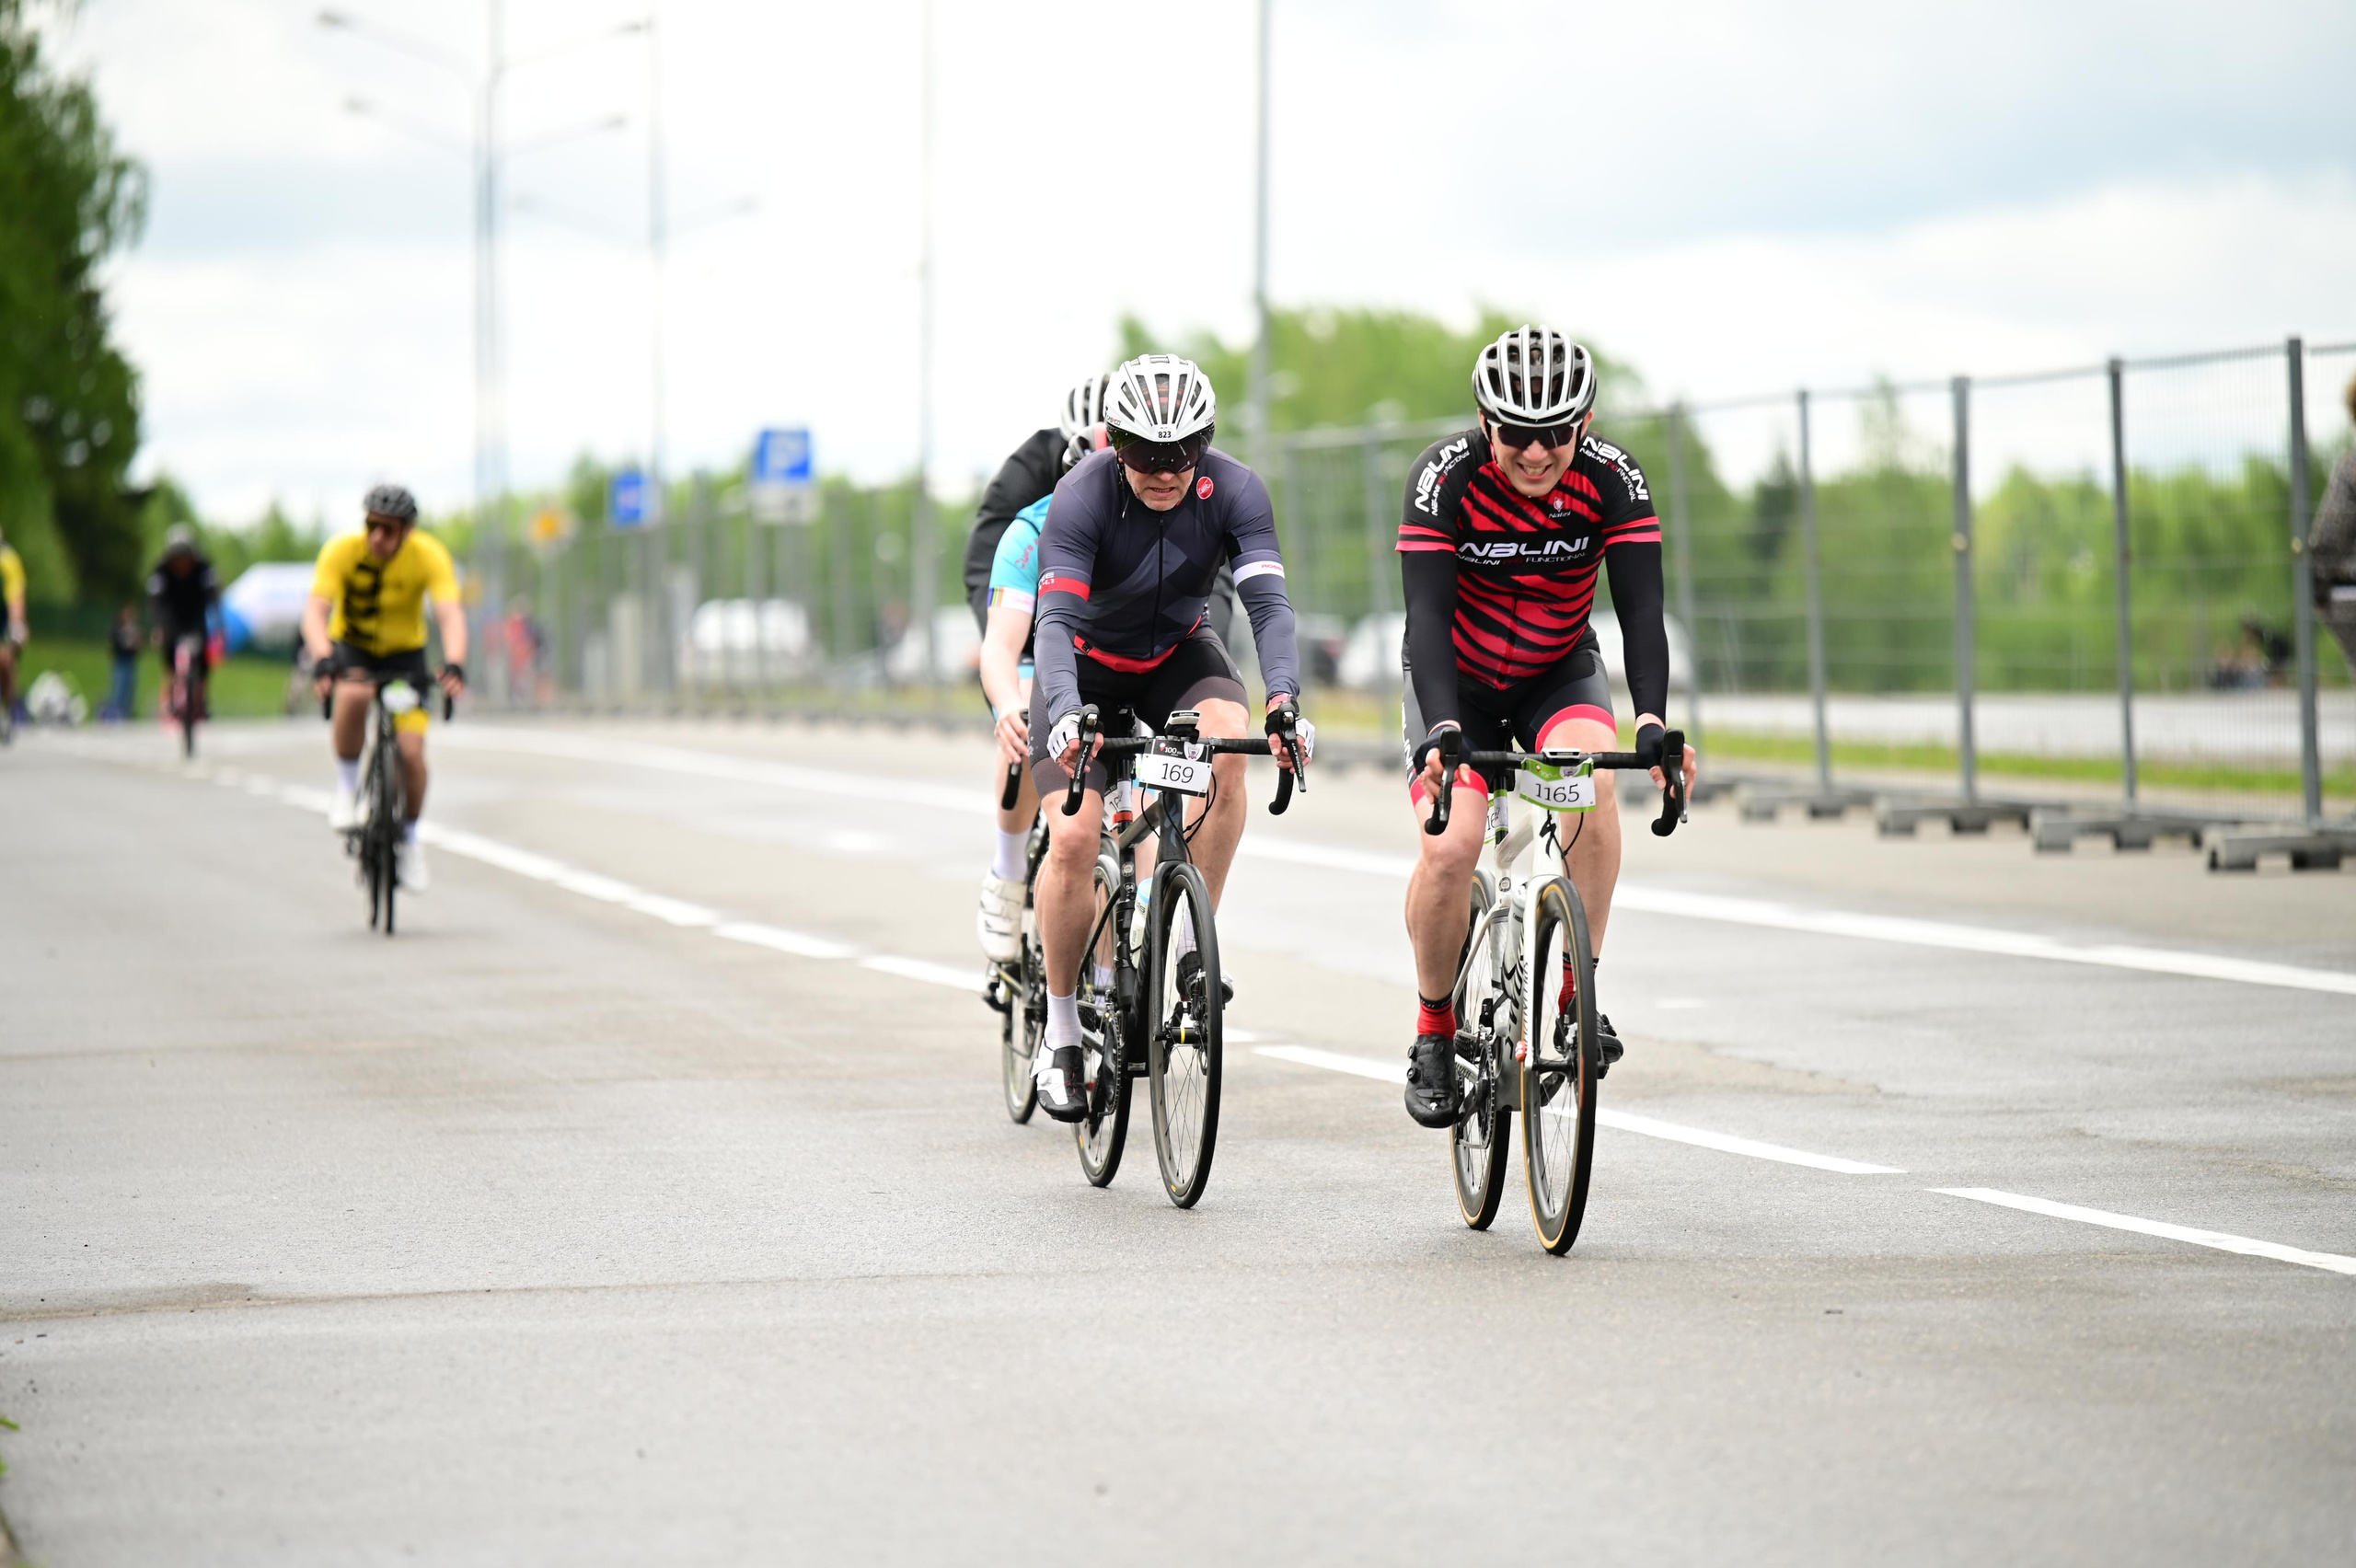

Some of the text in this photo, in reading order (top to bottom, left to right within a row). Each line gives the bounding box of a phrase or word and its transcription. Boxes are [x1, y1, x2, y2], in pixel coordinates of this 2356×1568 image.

[1525, 551, 1588, 563] FUNCTIONAL
[1161, 763, 1195, 784] 169
[1535, 783, 1580, 803] 1165
